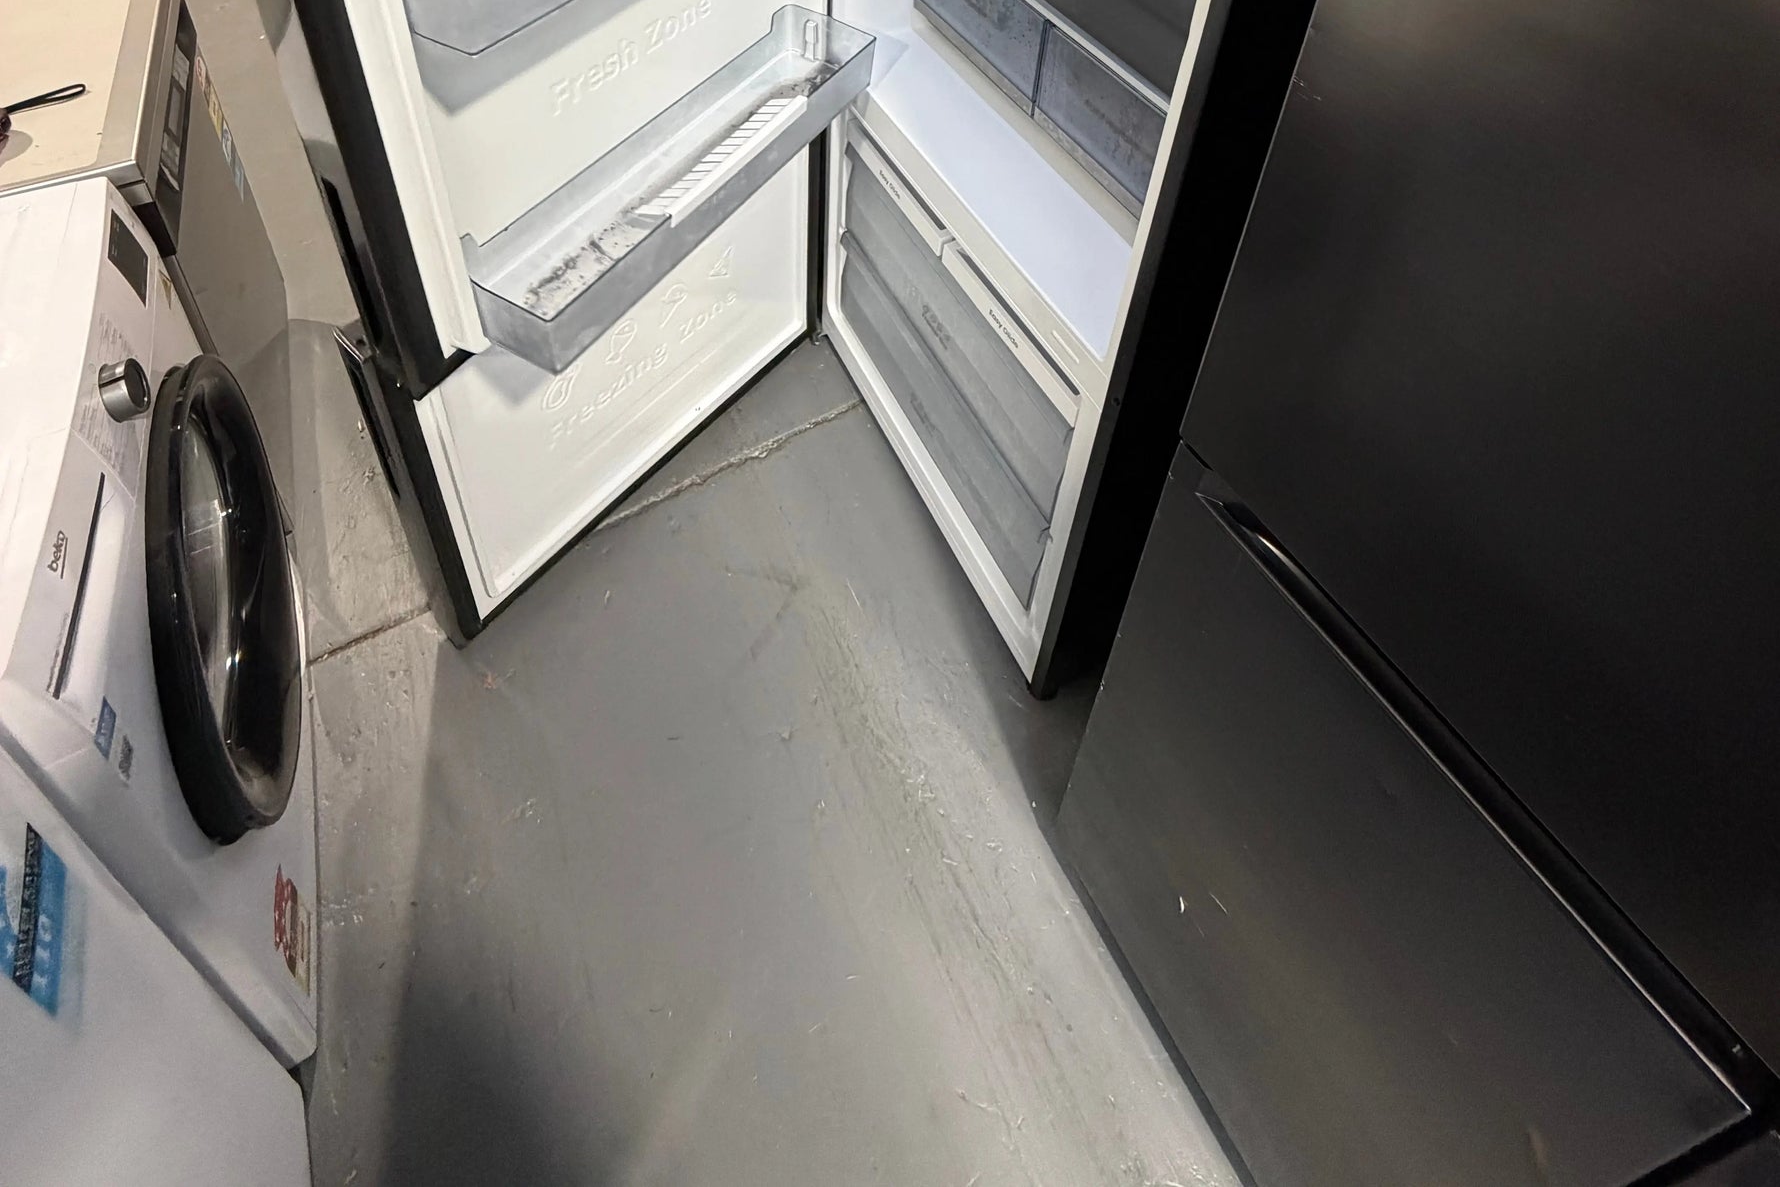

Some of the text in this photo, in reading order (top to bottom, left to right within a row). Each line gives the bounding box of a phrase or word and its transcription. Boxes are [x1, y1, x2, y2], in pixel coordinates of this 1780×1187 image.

[550, 37, 640, 118] Fresh
[989, 308, 1003, 329] Easy
[46, 529, 66, 573] beko
